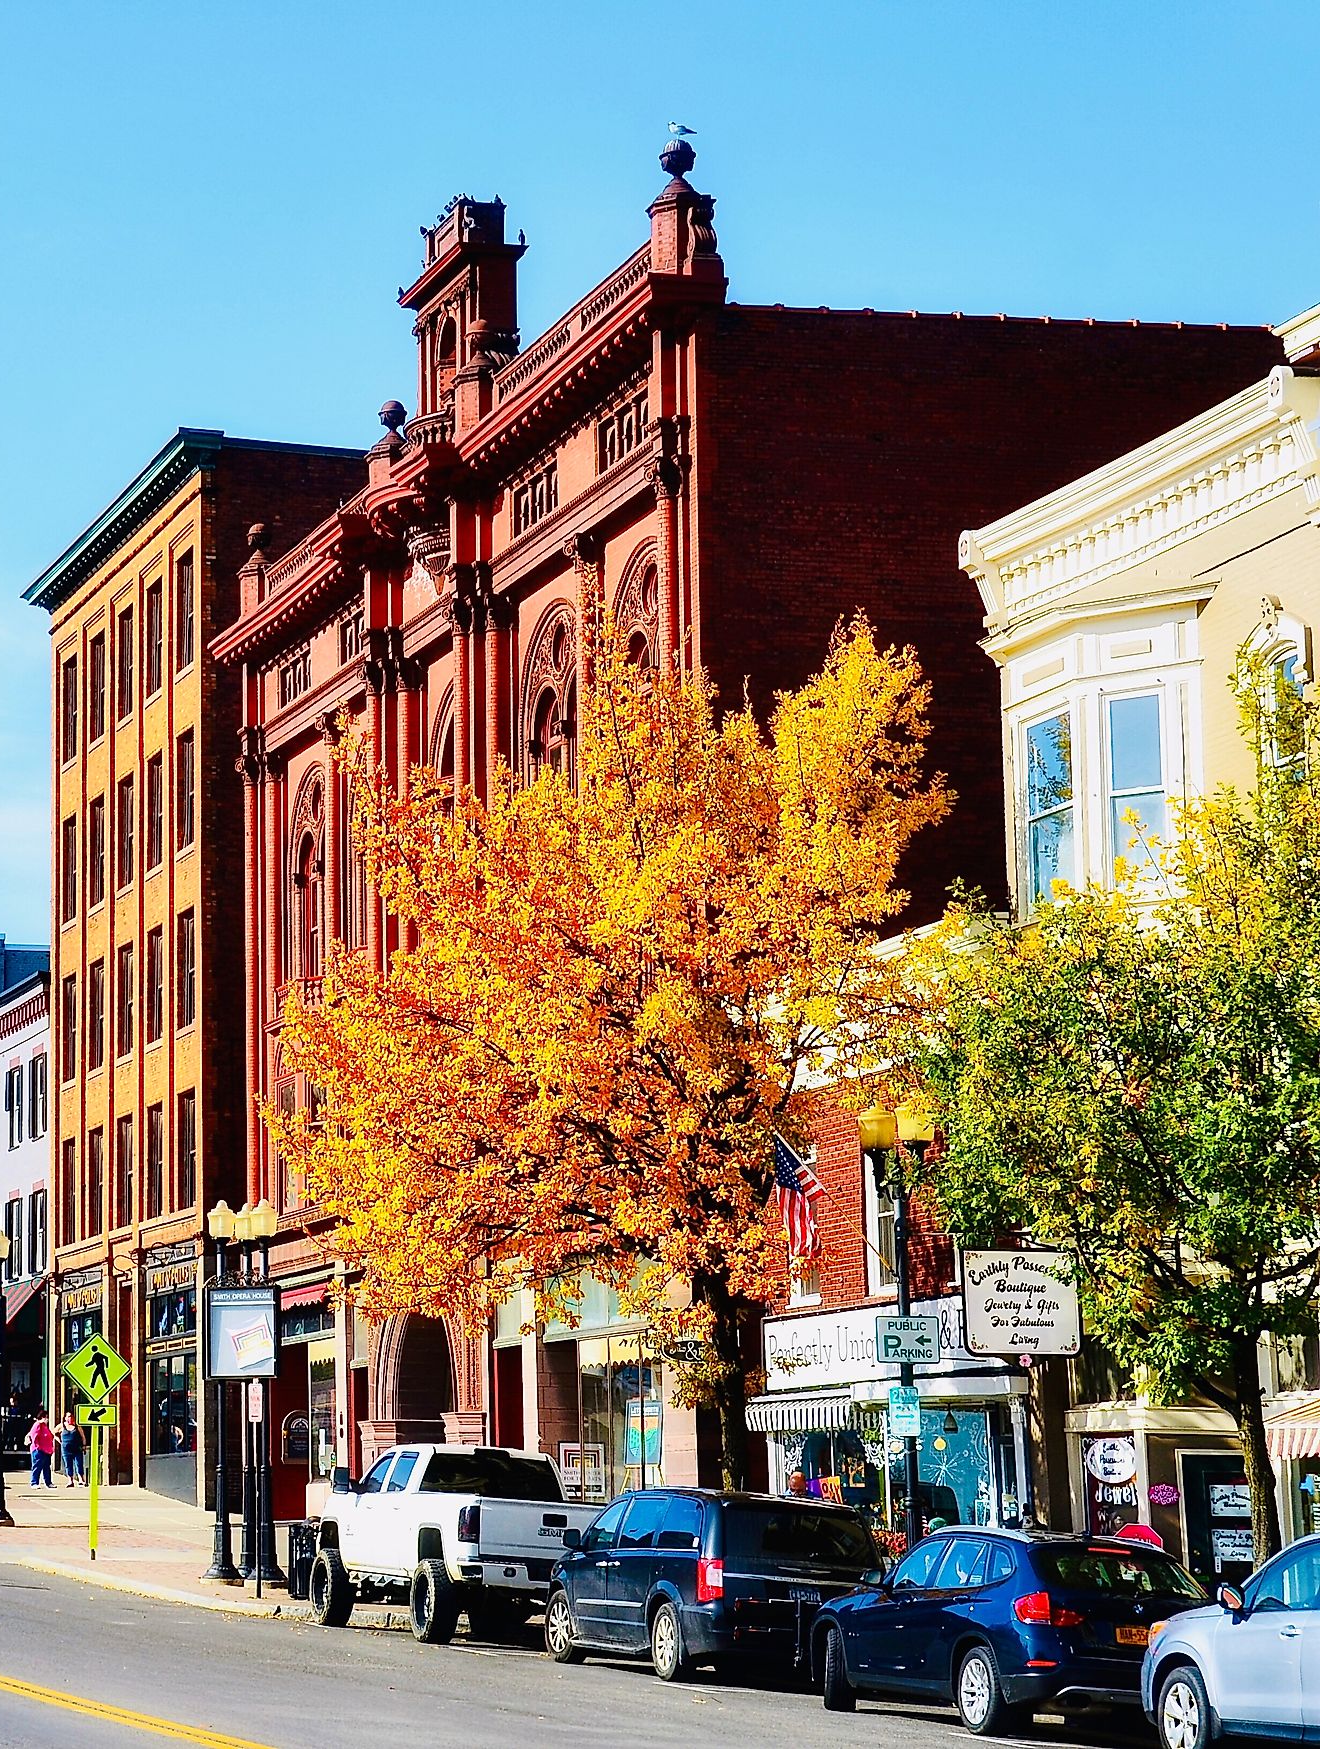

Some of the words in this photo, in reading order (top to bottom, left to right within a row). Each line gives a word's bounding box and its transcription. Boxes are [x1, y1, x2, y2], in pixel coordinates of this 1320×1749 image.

[968, 1260, 1009, 1286] Earthly
[994, 1278, 1047, 1298] Boutique
[1024, 1299, 1033, 1310] &
[1037, 1299, 1060, 1316] Gifts
[887, 1321, 927, 1332] PUBLIC
[990, 1315, 1009, 1328] For
[1011, 1315, 1055, 1328] Fabulous
[768, 1328, 833, 1372] Perfectly
[837, 1326, 876, 1368] Uniq
[883, 1335, 933, 1359] PARKING
[1095, 1481, 1139, 1506] Jewel
[537, 1528, 564, 1537] GM
